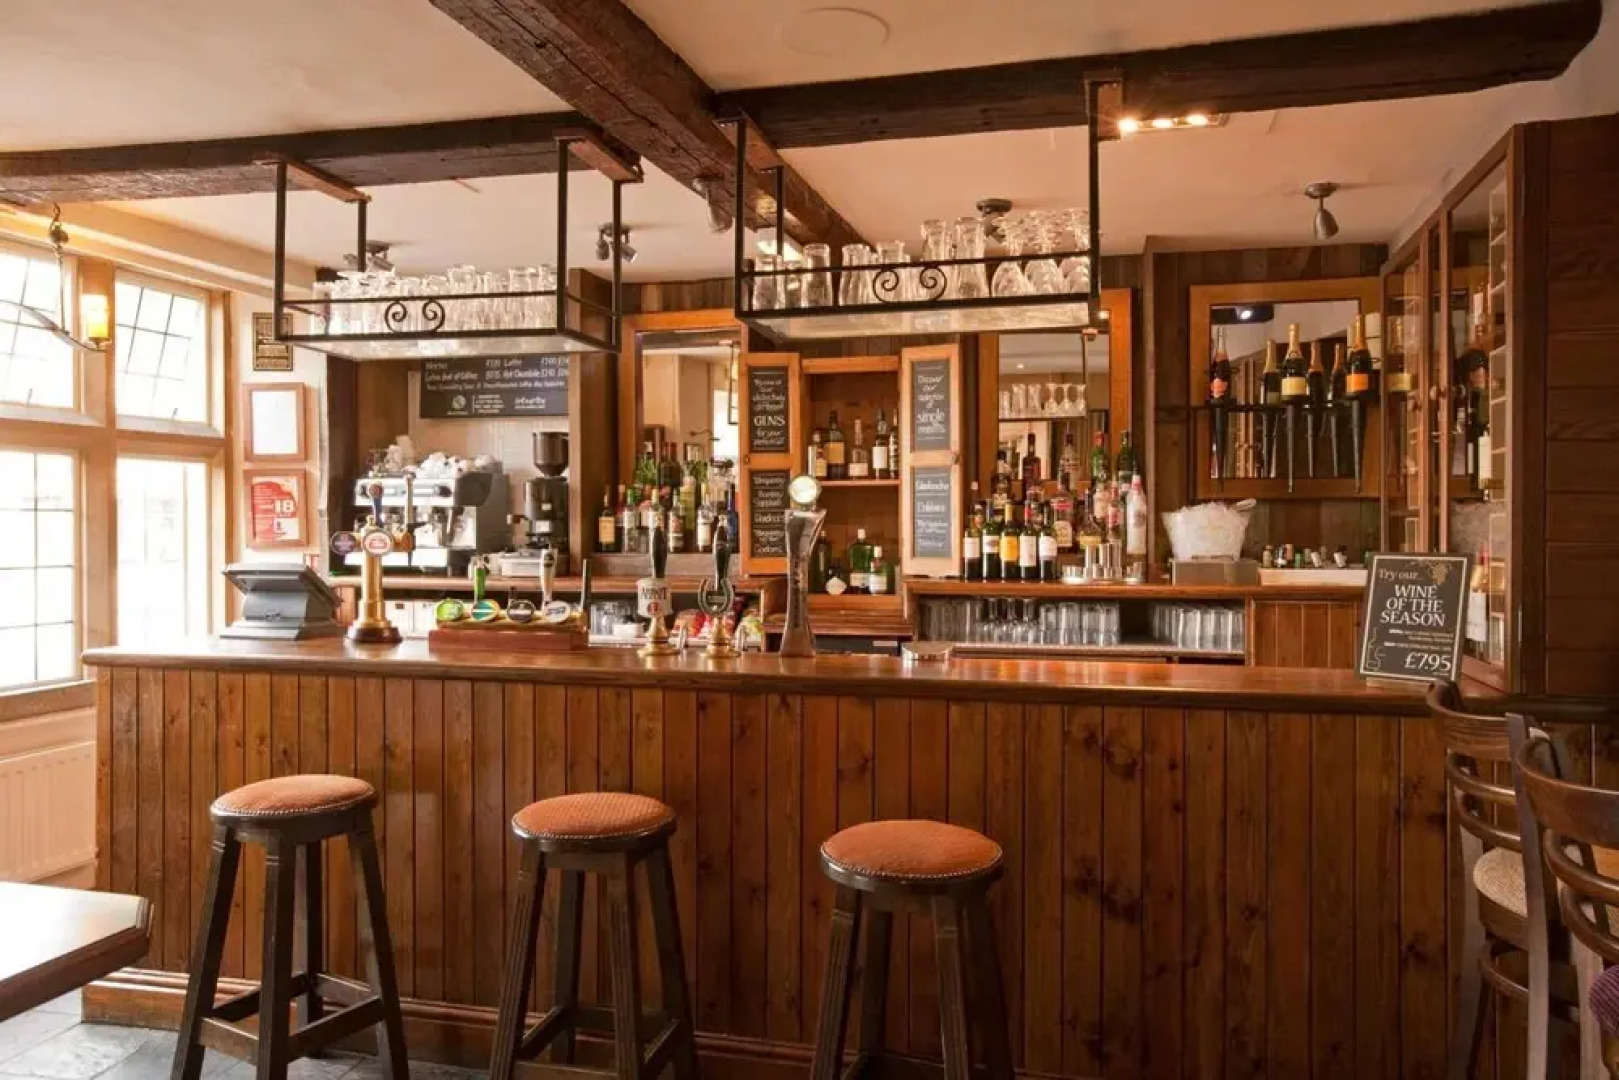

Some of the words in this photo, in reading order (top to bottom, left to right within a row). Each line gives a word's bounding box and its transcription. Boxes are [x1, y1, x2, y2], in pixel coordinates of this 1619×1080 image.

[753, 415, 786, 427] GINS
[274, 499, 294, 513] 18
[1378, 569, 1396, 581] Try
[1394, 584, 1438, 599] WINE
[1386, 597, 1407, 611] OF
[1409, 598, 1443, 613] THE
[1380, 610, 1445, 627] SEASON
[1404, 651, 1451, 671] £7.95
